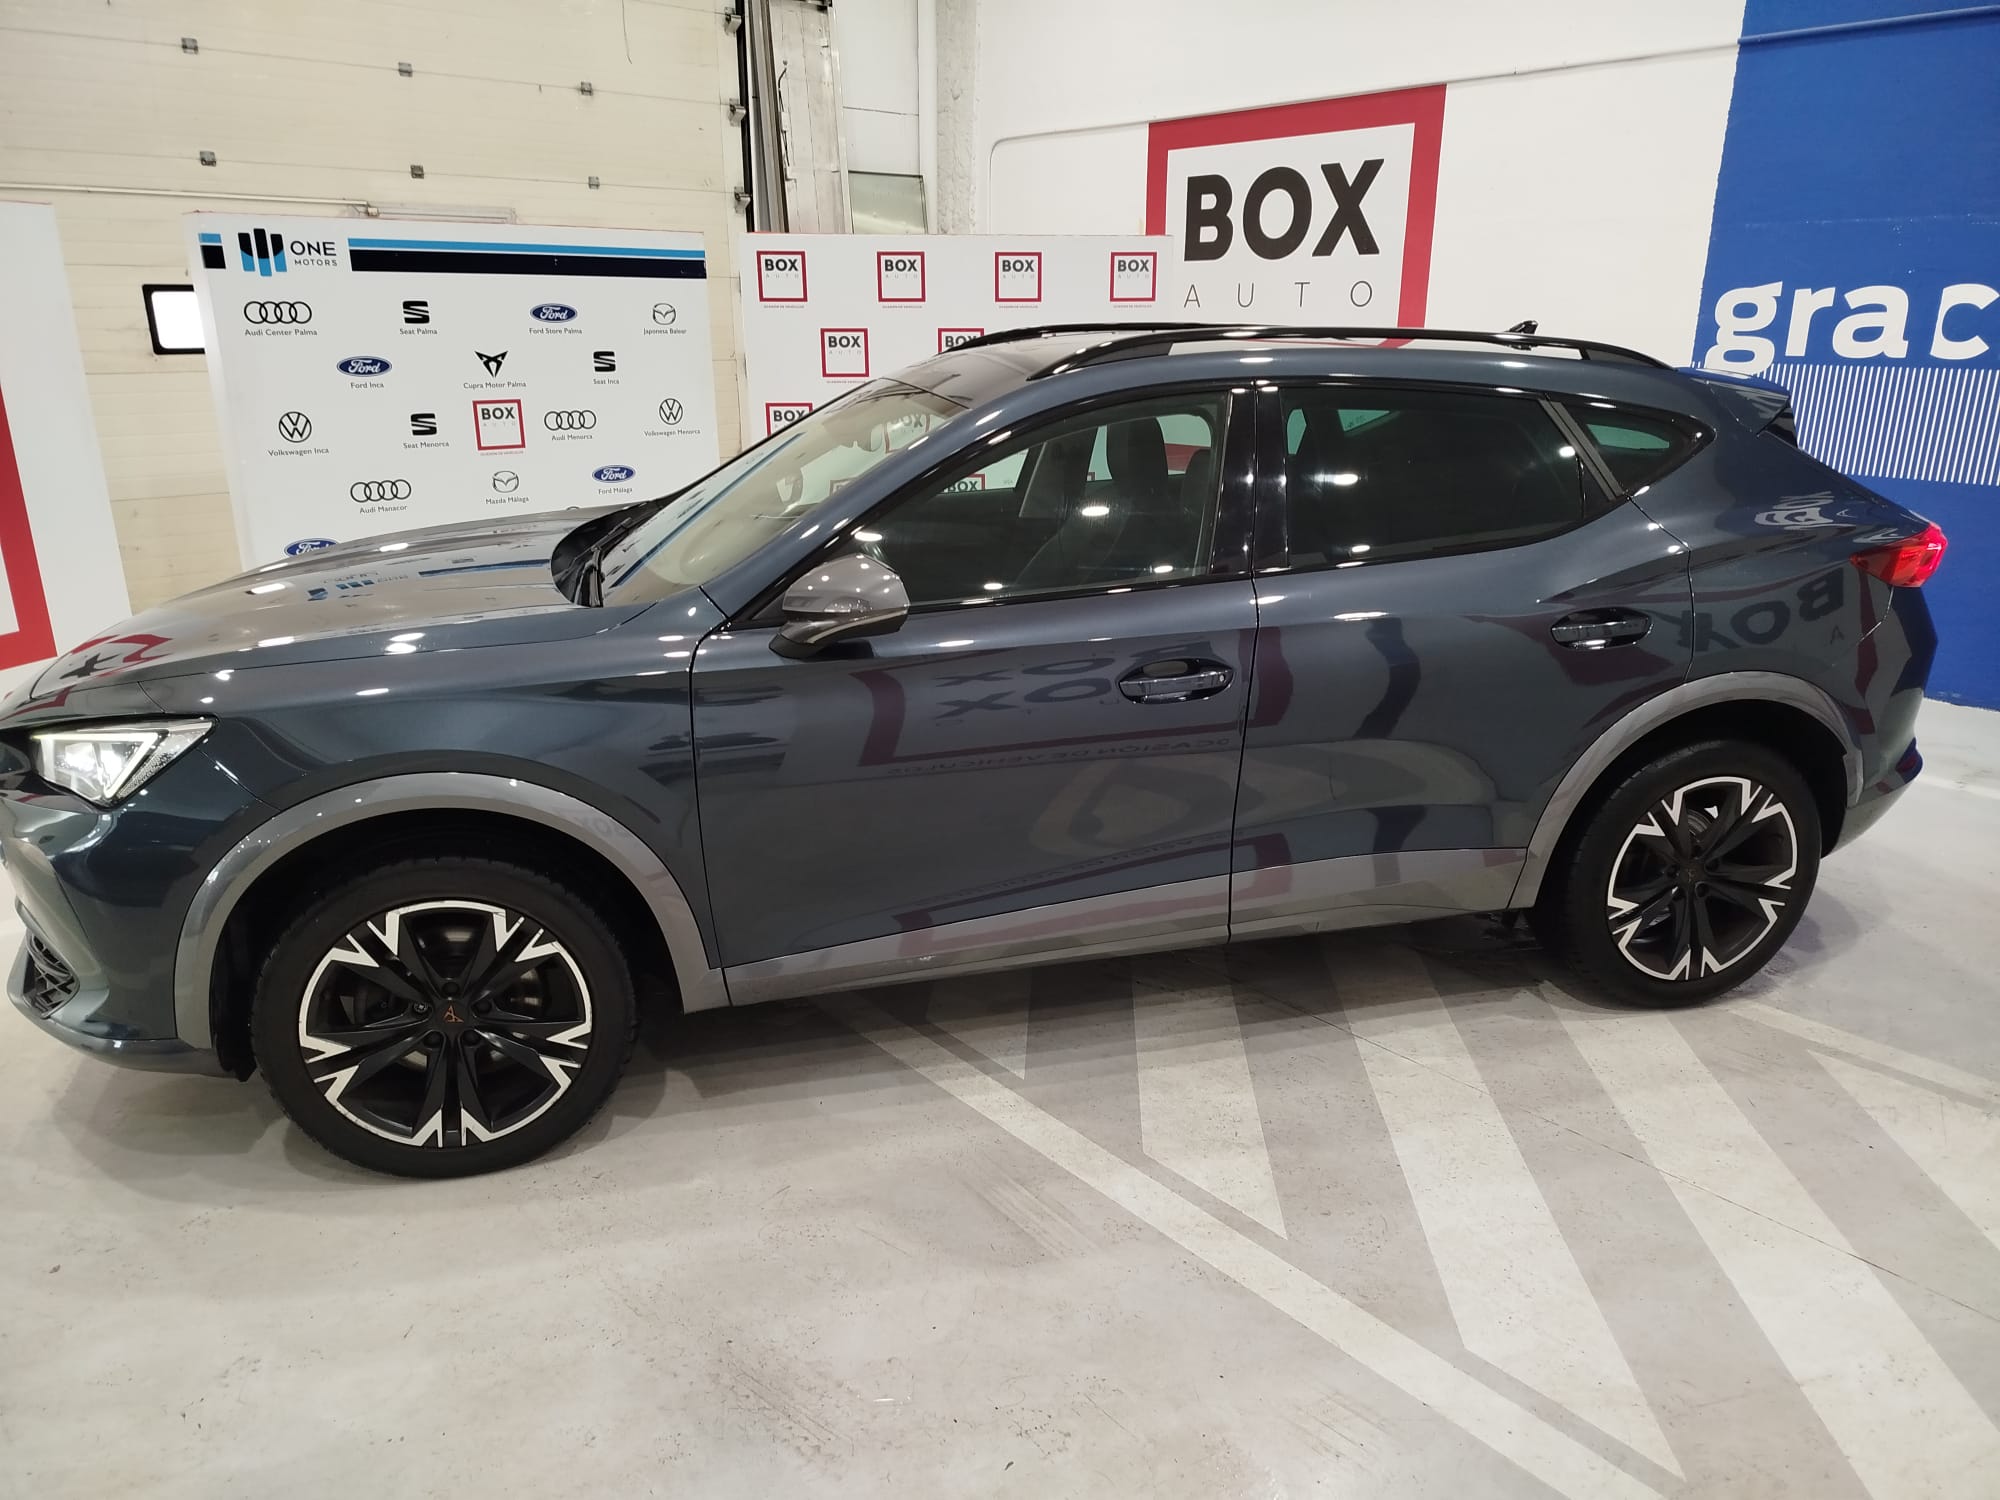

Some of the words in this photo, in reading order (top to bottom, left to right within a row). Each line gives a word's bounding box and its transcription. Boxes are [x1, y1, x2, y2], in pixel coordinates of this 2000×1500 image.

[1184, 158, 1385, 262] BOX
[290, 240, 337, 256] ONE
[294, 258, 338, 267] MOTORS
[764, 258, 799, 272] BOX
[883, 259, 918, 272] BOX
[1001, 259, 1035, 272] BOX
[1116, 259, 1150, 272] BOX
[1184, 280, 1373, 309] AUTO
[244, 328, 264, 336] Audi
[294, 328, 318, 336] Palma
[399, 327, 415, 335] Seat
[416, 327, 438, 335] Palma
[529, 327, 544, 335] Ford
[545, 327, 563, 335] Store
[564, 327, 583, 335] Palma
[827, 335, 861, 348] BOX
[350, 381, 368, 389] Ford
[369, 381, 384, 389] Inca
[463, 382, 484, 390] Cupra
[507, 380, 527, 388] Palma
[481, 407, 516, 420] BOX
[677, 428, 701, 436] Menorca
[551, 434, 566, 442] Audi
[418, 440, 450, 448] Menorca
[267, 449, 312, 458] Volkswagen
[313, 447, 329, 455] Inca
[598, 487, 613, 495] Ford
[378, 505, 408, 513] Manacor
